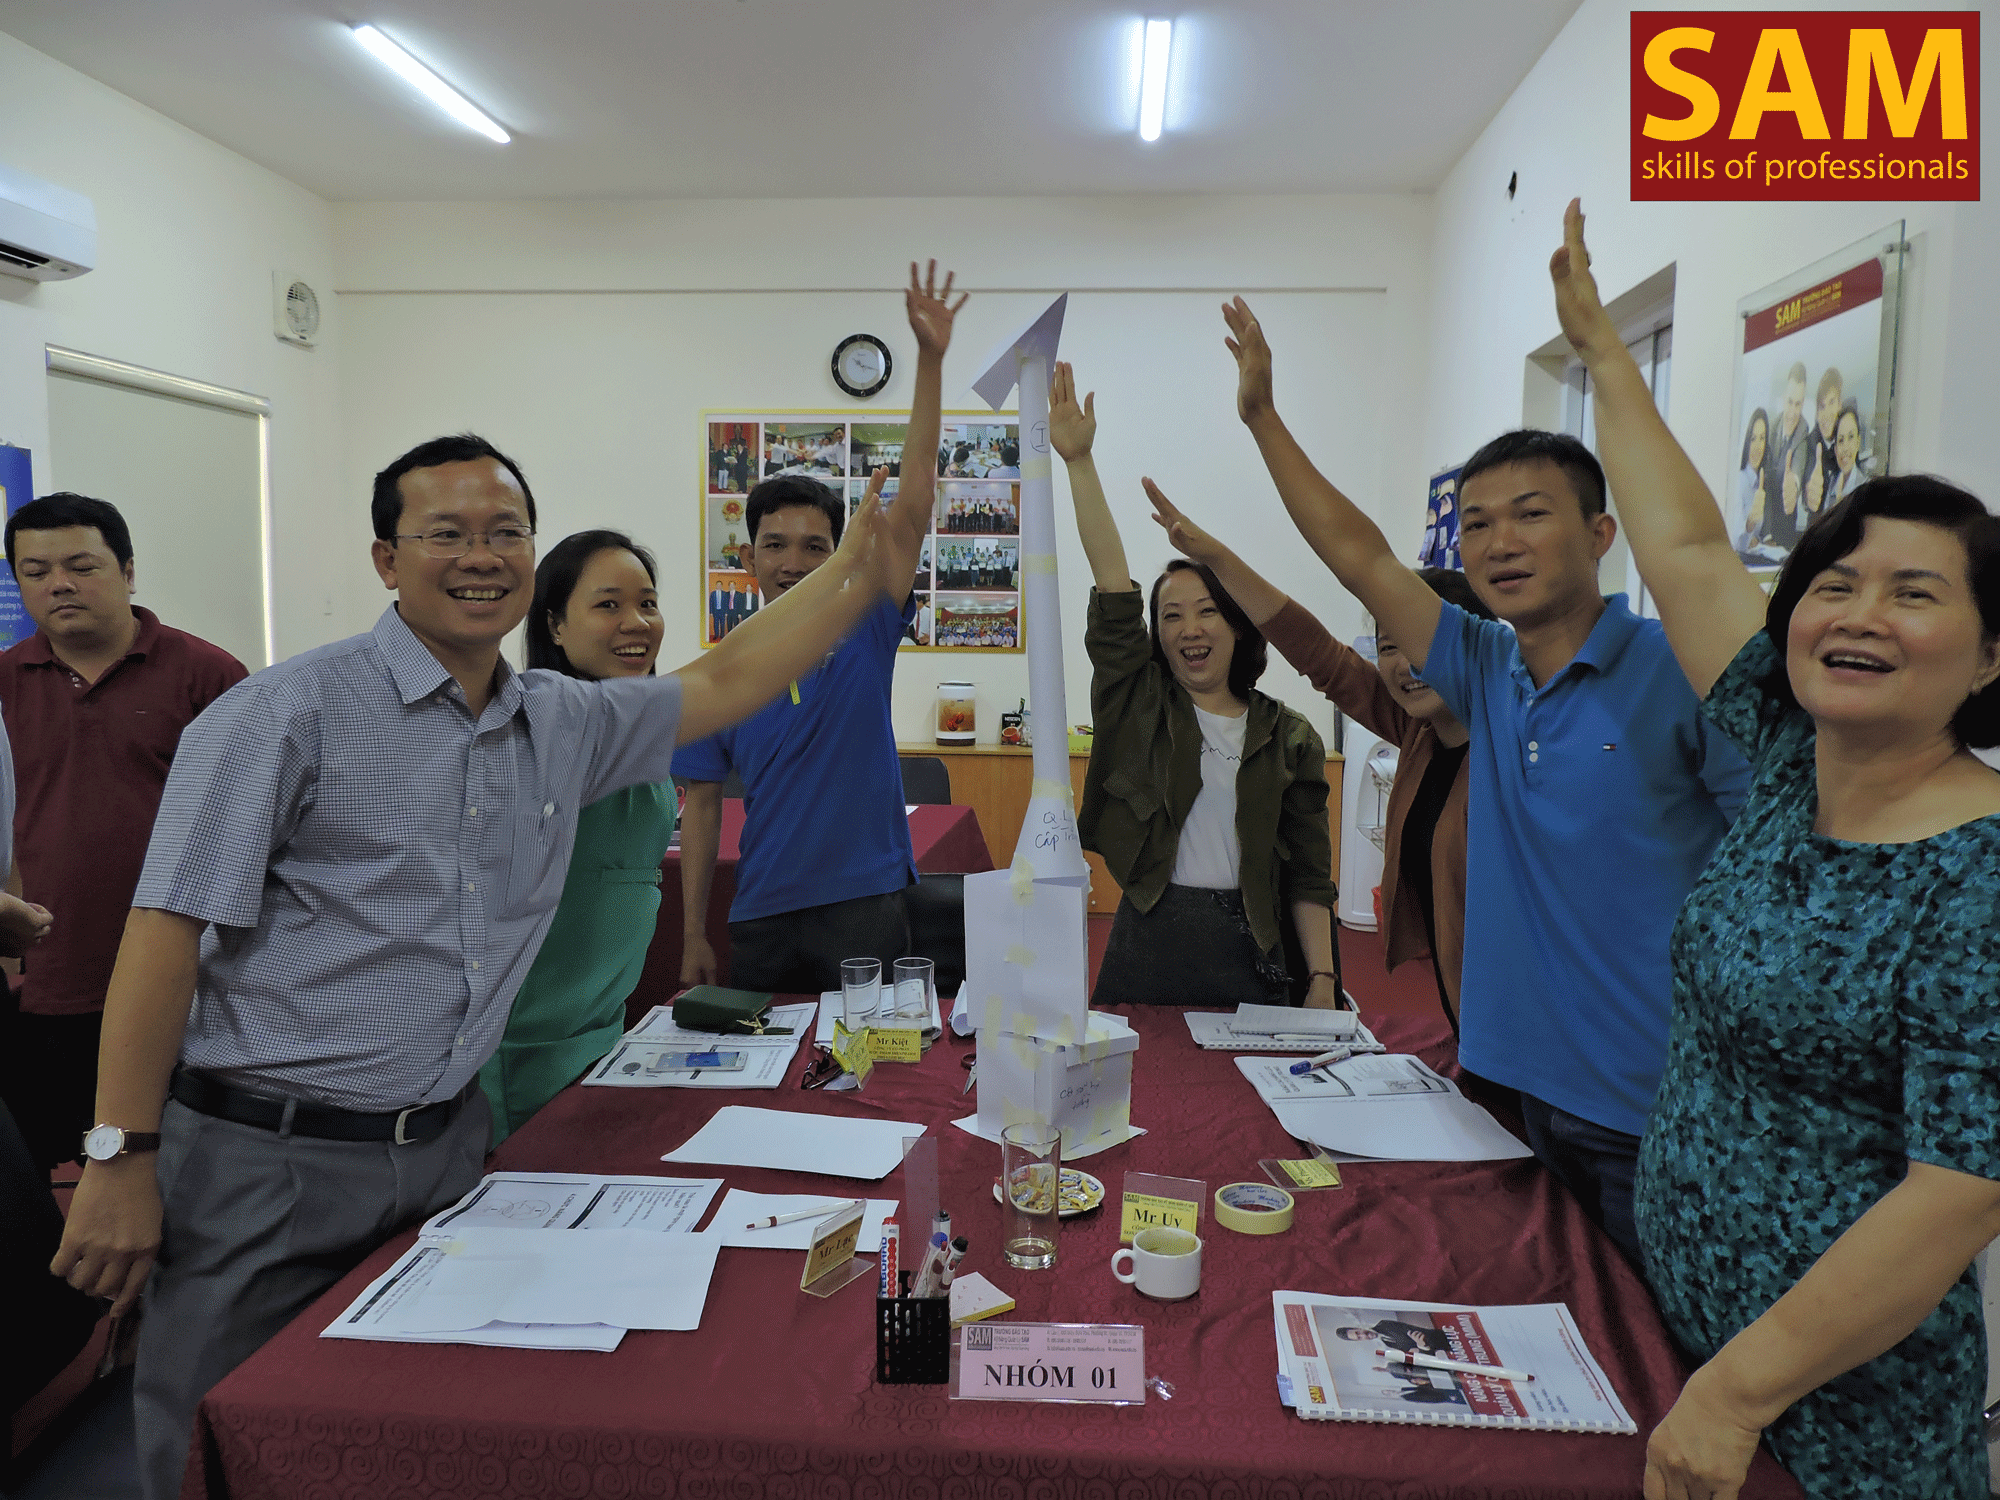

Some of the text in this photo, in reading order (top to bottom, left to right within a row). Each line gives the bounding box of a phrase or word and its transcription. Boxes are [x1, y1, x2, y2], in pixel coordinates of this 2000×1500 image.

[1775, 299, 1802, 329] SAM
[876, 1037, 889, 1045] Mr
[1133, 1208, 1157, 1223] Mr
[968, 1327, 992, 1345] SAM
[1441, 1325, 1460, 1340] LỰC
[984, 1359, 1118, 1389] NHÓM 01
